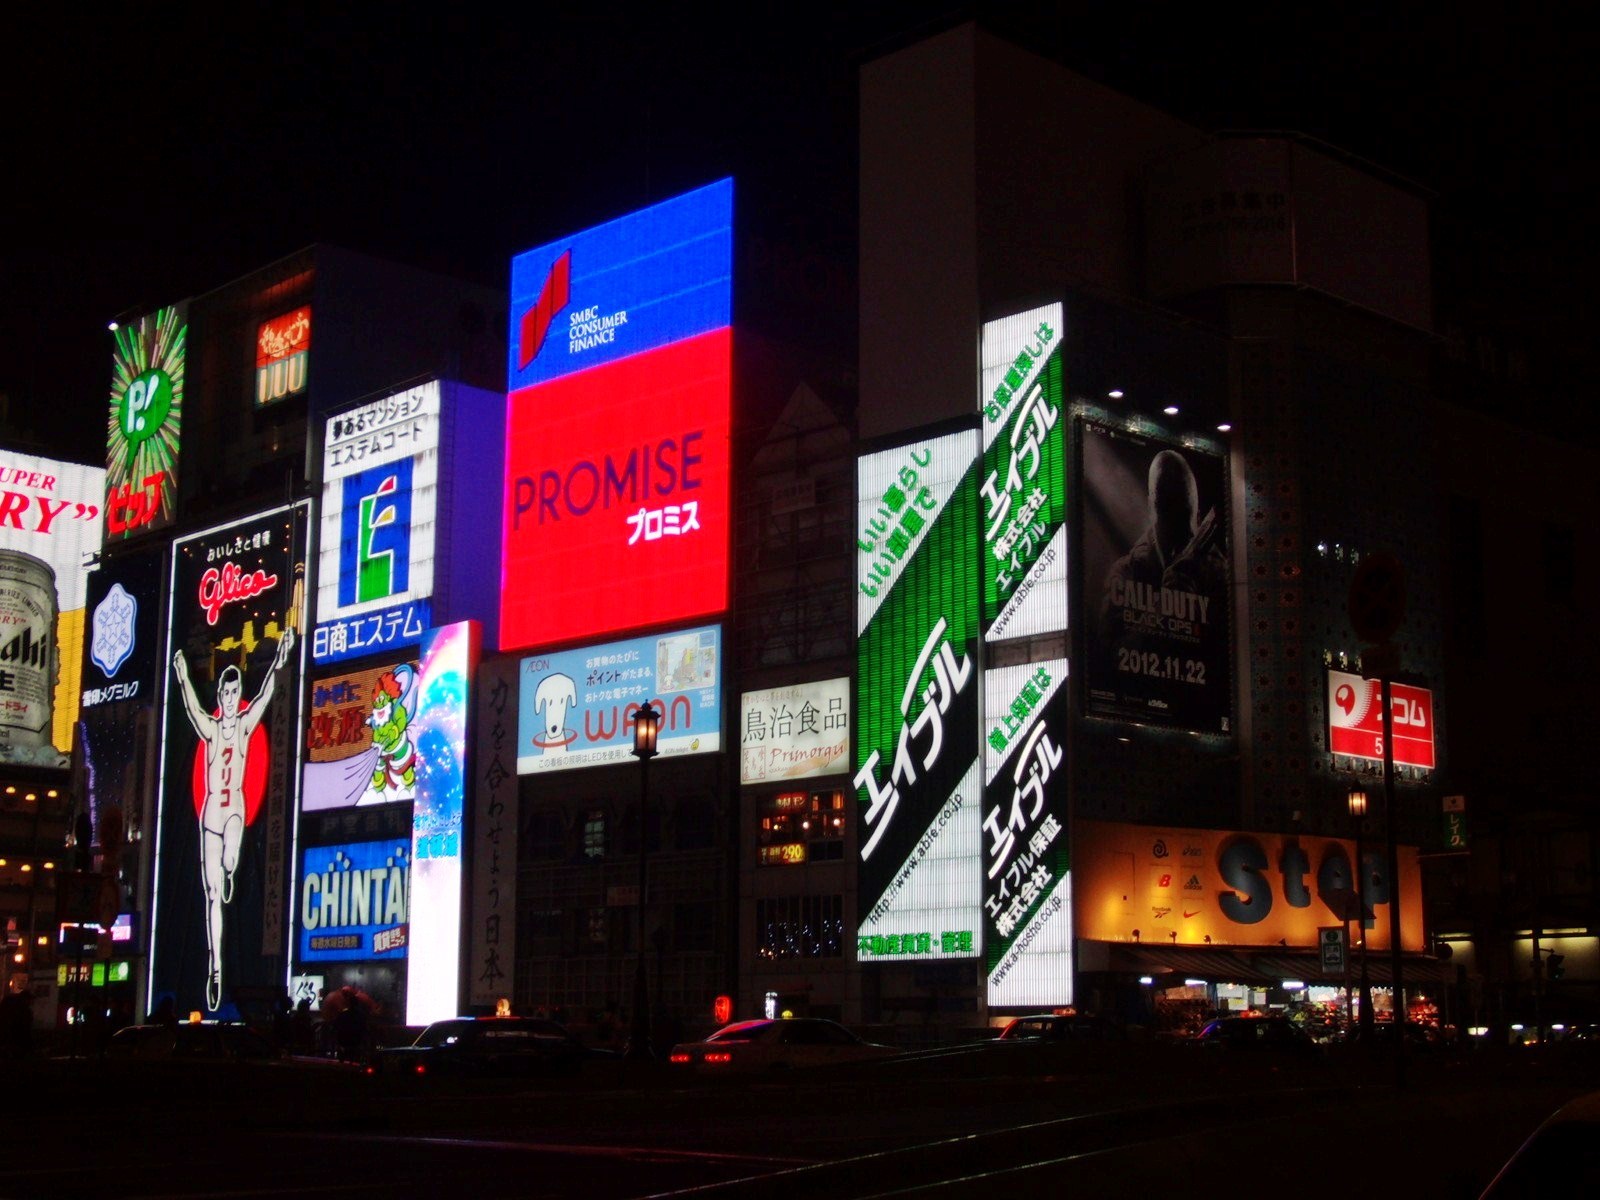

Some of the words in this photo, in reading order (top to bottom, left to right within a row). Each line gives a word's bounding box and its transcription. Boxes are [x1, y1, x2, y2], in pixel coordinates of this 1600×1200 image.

[569, 306, 599, 326] SMBC
[569, 311, 628, 340] CONSUMER
[569, 329, 615, 353] FINANCE
[331, 421, 422, 468] エステムコート
[514, 430, 704, 531] PROMISE
[626, 501, 701, 545] プロミス
[993, 487, 1048, 561] 株式会社
[995, 521, 1047, 592] エイブル
[199, 561, 277, 625] Glico
[993, 548, 1057, 636] www.able.co.jp
[1110, 577, 1156, 613] CALL
[1160, 587, 1211, 624] DUTY
[0, 626, 47, 670] ahi
[313, 607, 422, 658] 日商エステム
[1118, 646, 1207, 685] 2012.11.22
[742, 698, 848, 744] 鳥治食品
[853, 617, 971, 862] エイブル
[220, 743, 234, 809] グリコ
[982, 719, 1063, 880] エイブル
[868, 792, 963, 925] http://www.able.co.jp
[996, 864, 1053, 938] 株式会社
